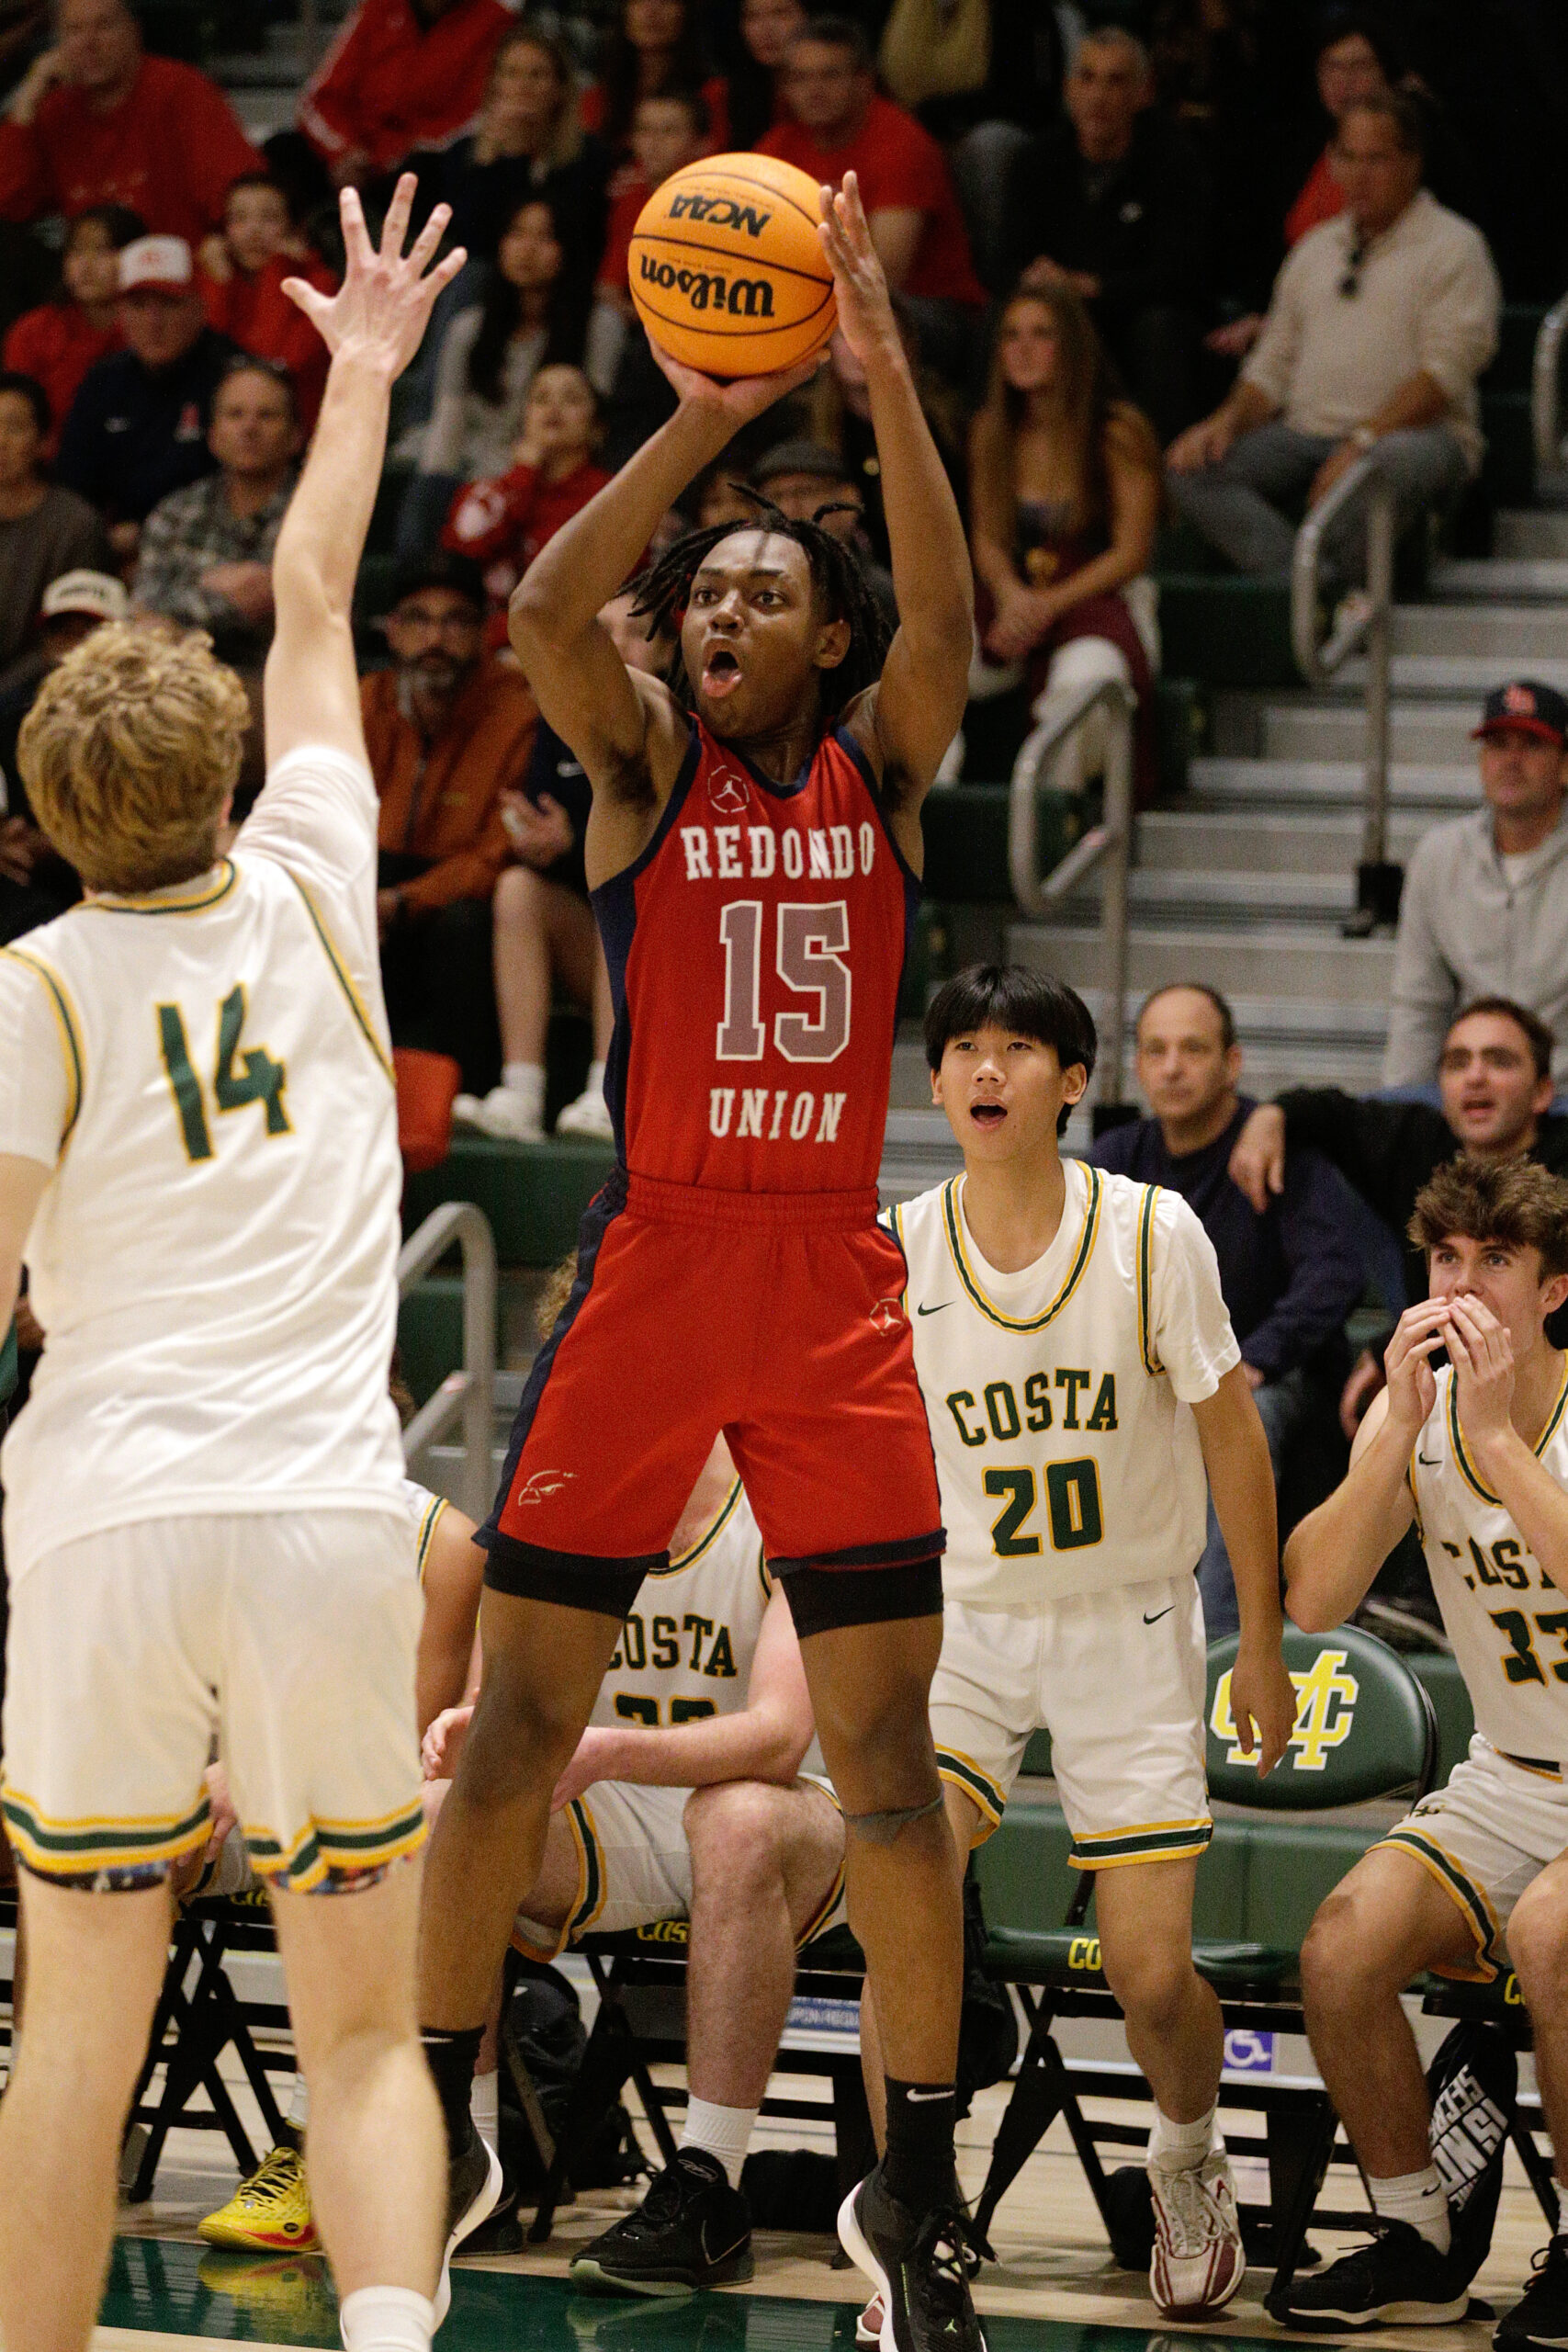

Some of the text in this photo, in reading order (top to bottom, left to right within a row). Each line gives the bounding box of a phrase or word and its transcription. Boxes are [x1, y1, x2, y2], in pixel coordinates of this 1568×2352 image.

[669, 193, 772, 238] NCAA
[640, 254, 775, 317] Wilson
[680, 821, 874, 881] REDONDO
[716, 899, 852, 1063] 15
[154, 980, 296, 1167] 14
[709, 1088, 847, 1143] UNION
[945, 1367, 1119, 1447] COSTA
[981, 1455, 1105, 1559] 20
[608, 1612, 738, 1679] OSTA
[1504, 1973, 1526, 2005] C
